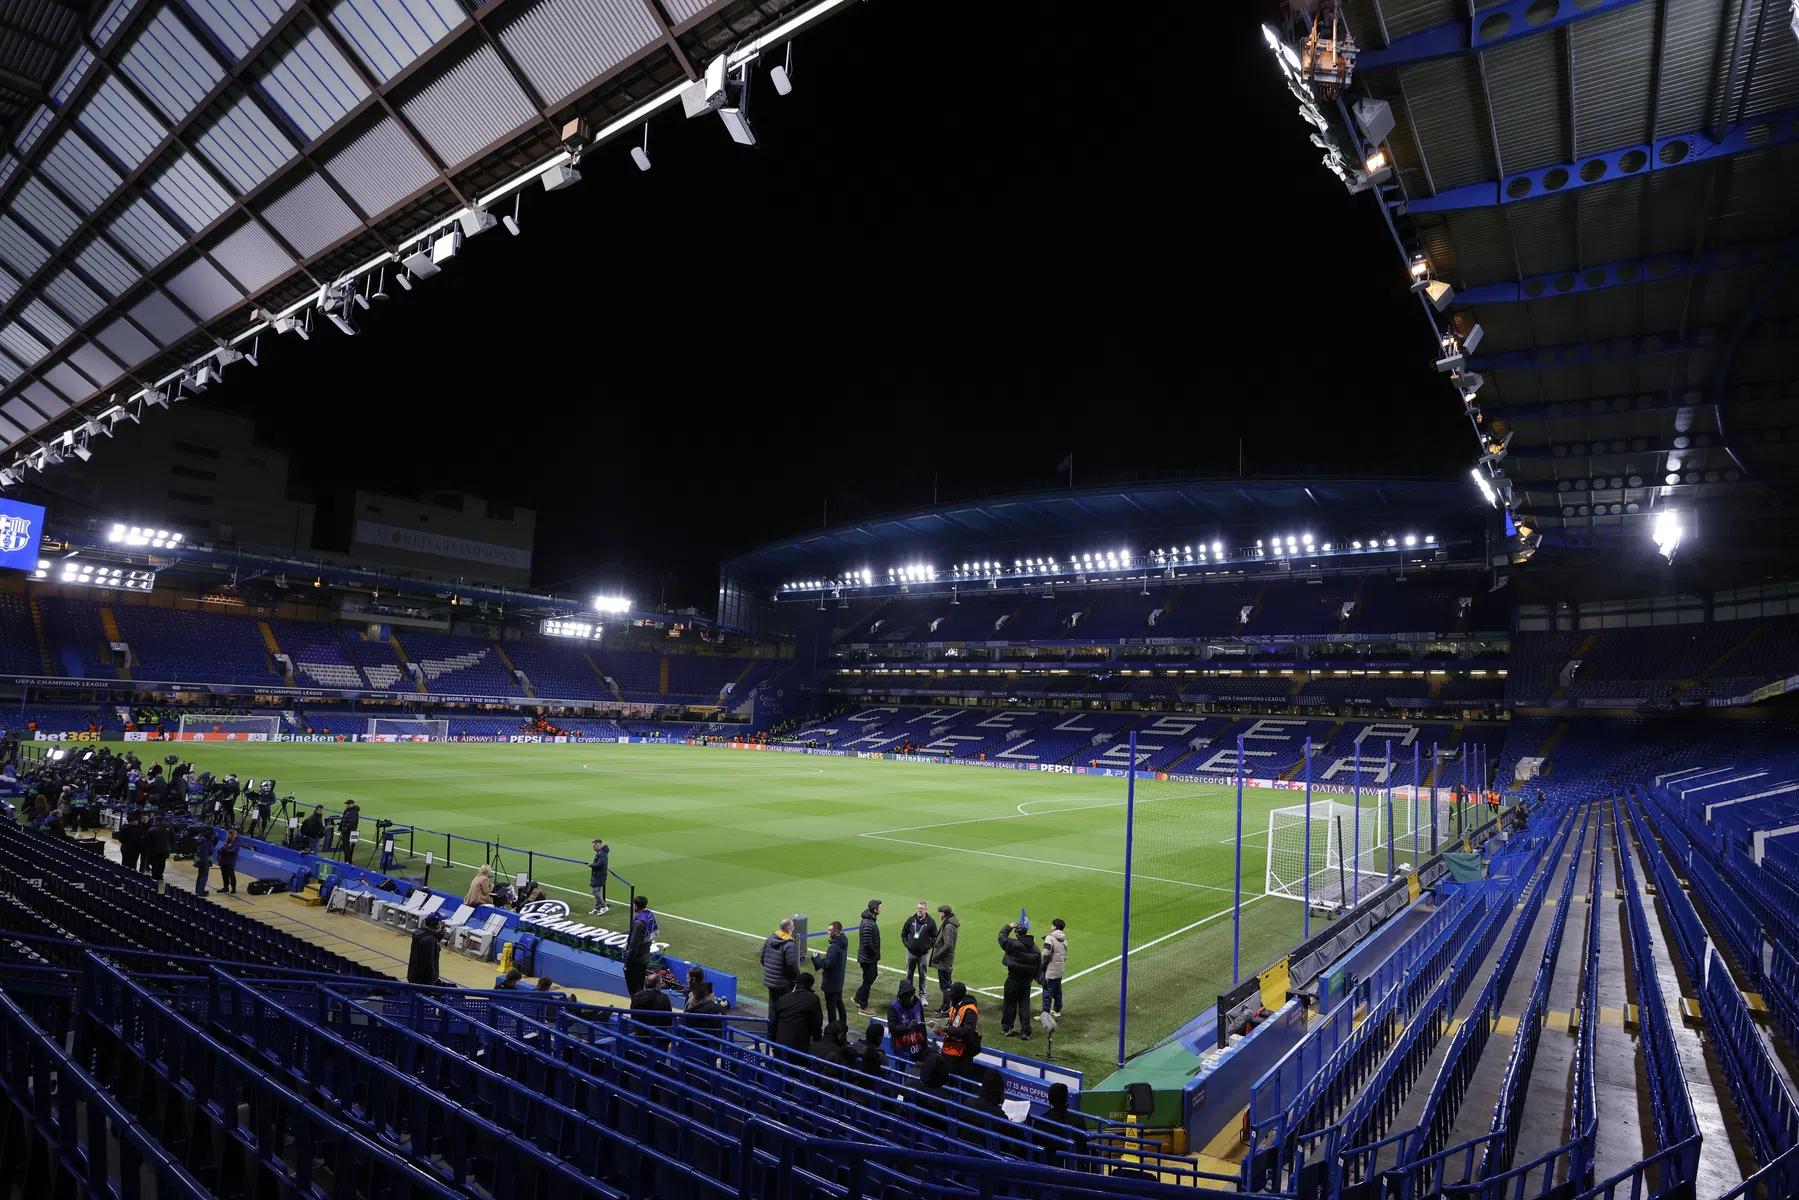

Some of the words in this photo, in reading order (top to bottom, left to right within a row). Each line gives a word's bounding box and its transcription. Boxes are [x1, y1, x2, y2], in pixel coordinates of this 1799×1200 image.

[848, 707, 1420, 746] CHELSEA
[34, 731, 100, 741] bet365
[273, 733, 334, 742] Heineken
[361, 734, 386, 742] edEx
[395, 734, 424, 742] FedEx
[858, 751, 883, 760] bet365
[896, 754, 930, 763] Heineken
[1041, 764, 1073, 773] PEPSI
[1170, 774, 1224, 784] mastercard
[1231, 777, 1260, 788] FdEx
[1272, 781, 1303, 791] FedEx
[1311, 784, 1344, 794] QATAR
[520, 912, 670, 952] CHAMPIOS
[1030, 1088, 1048, 1098] OFFEN
